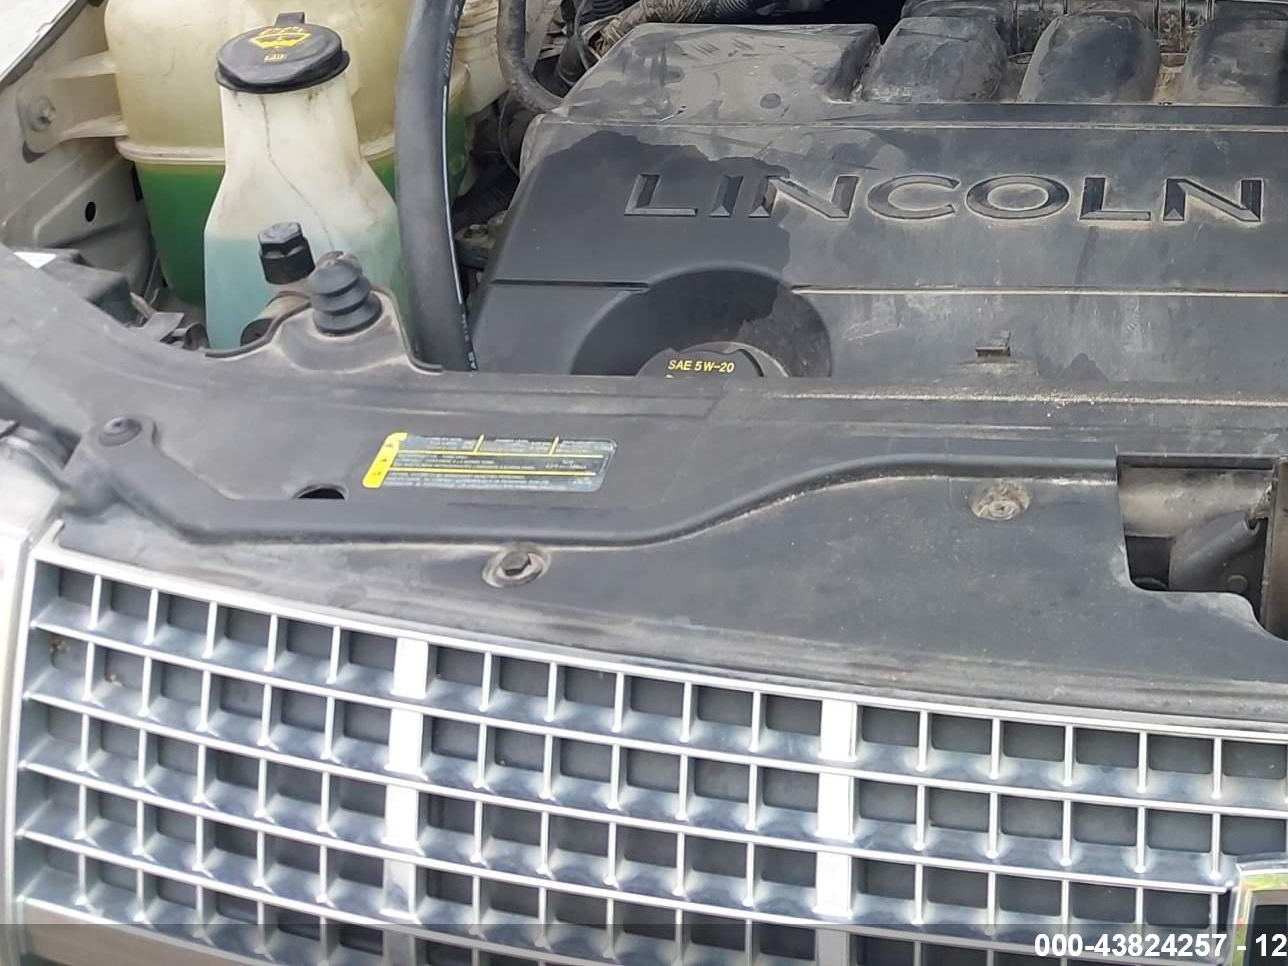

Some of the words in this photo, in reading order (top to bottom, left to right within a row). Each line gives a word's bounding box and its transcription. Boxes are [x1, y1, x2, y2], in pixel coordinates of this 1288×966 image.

[624, 174, 1264, 222] LINCOLN
[667, 360, 692, 371] SAE
[694, 361, 735, 373] 5W-20
